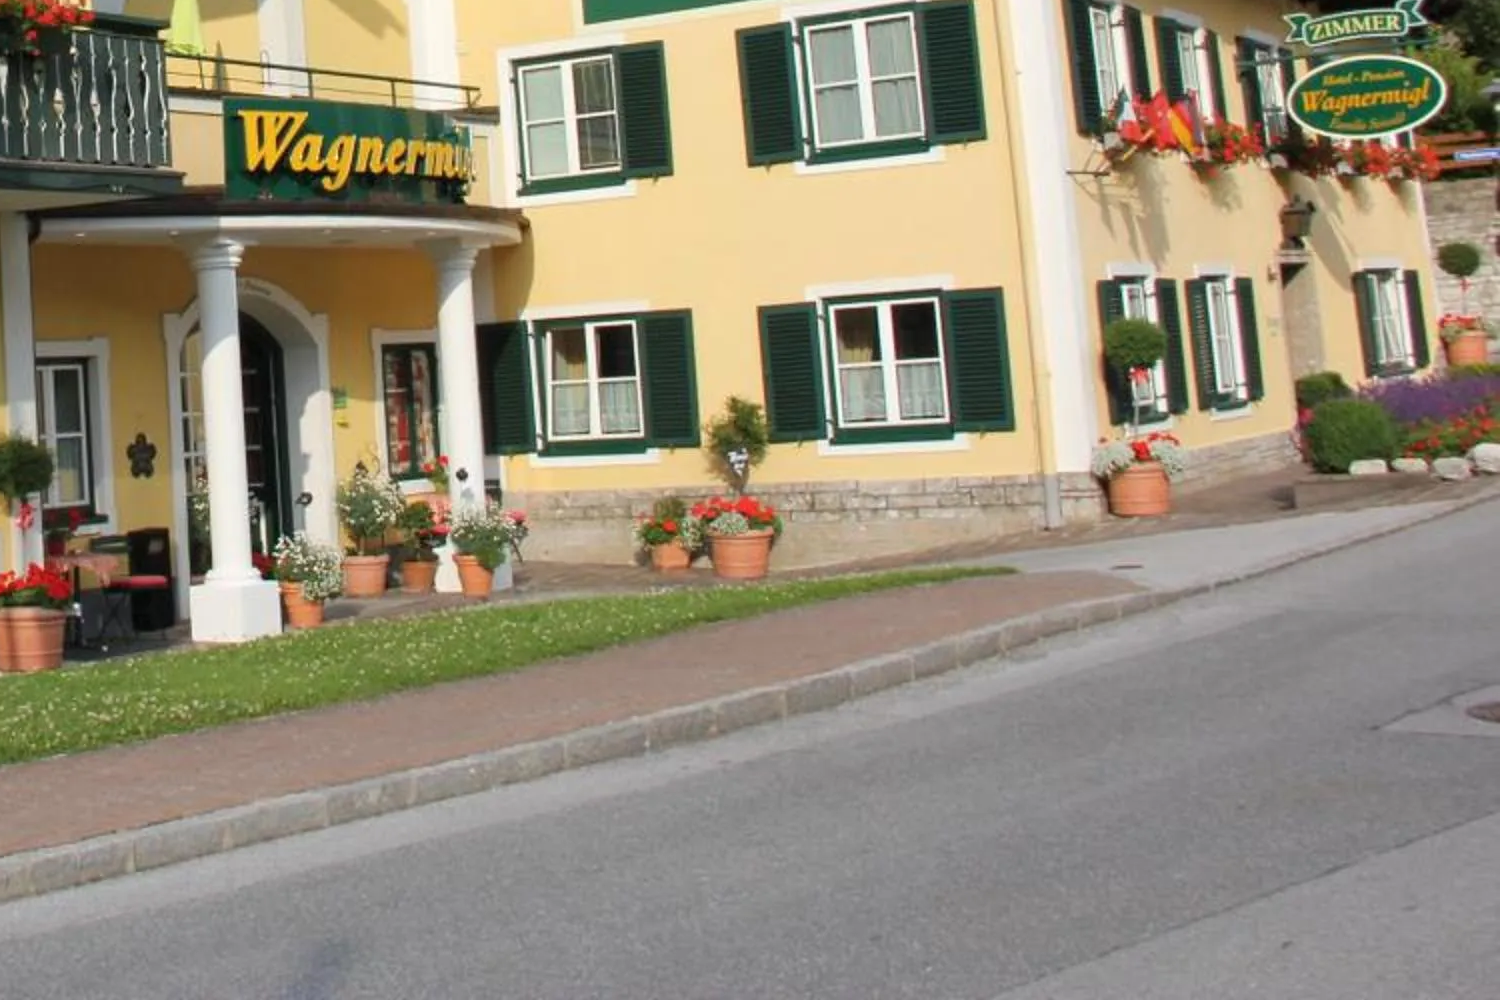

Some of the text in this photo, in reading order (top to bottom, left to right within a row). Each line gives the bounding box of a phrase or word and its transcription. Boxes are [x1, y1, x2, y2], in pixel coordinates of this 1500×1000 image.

[1310, 15, 1401, 41] ZIMMER
[1302, 76, 1431, 116] Wagnermigl
[237, 109, 475, 193] Wagnermi
